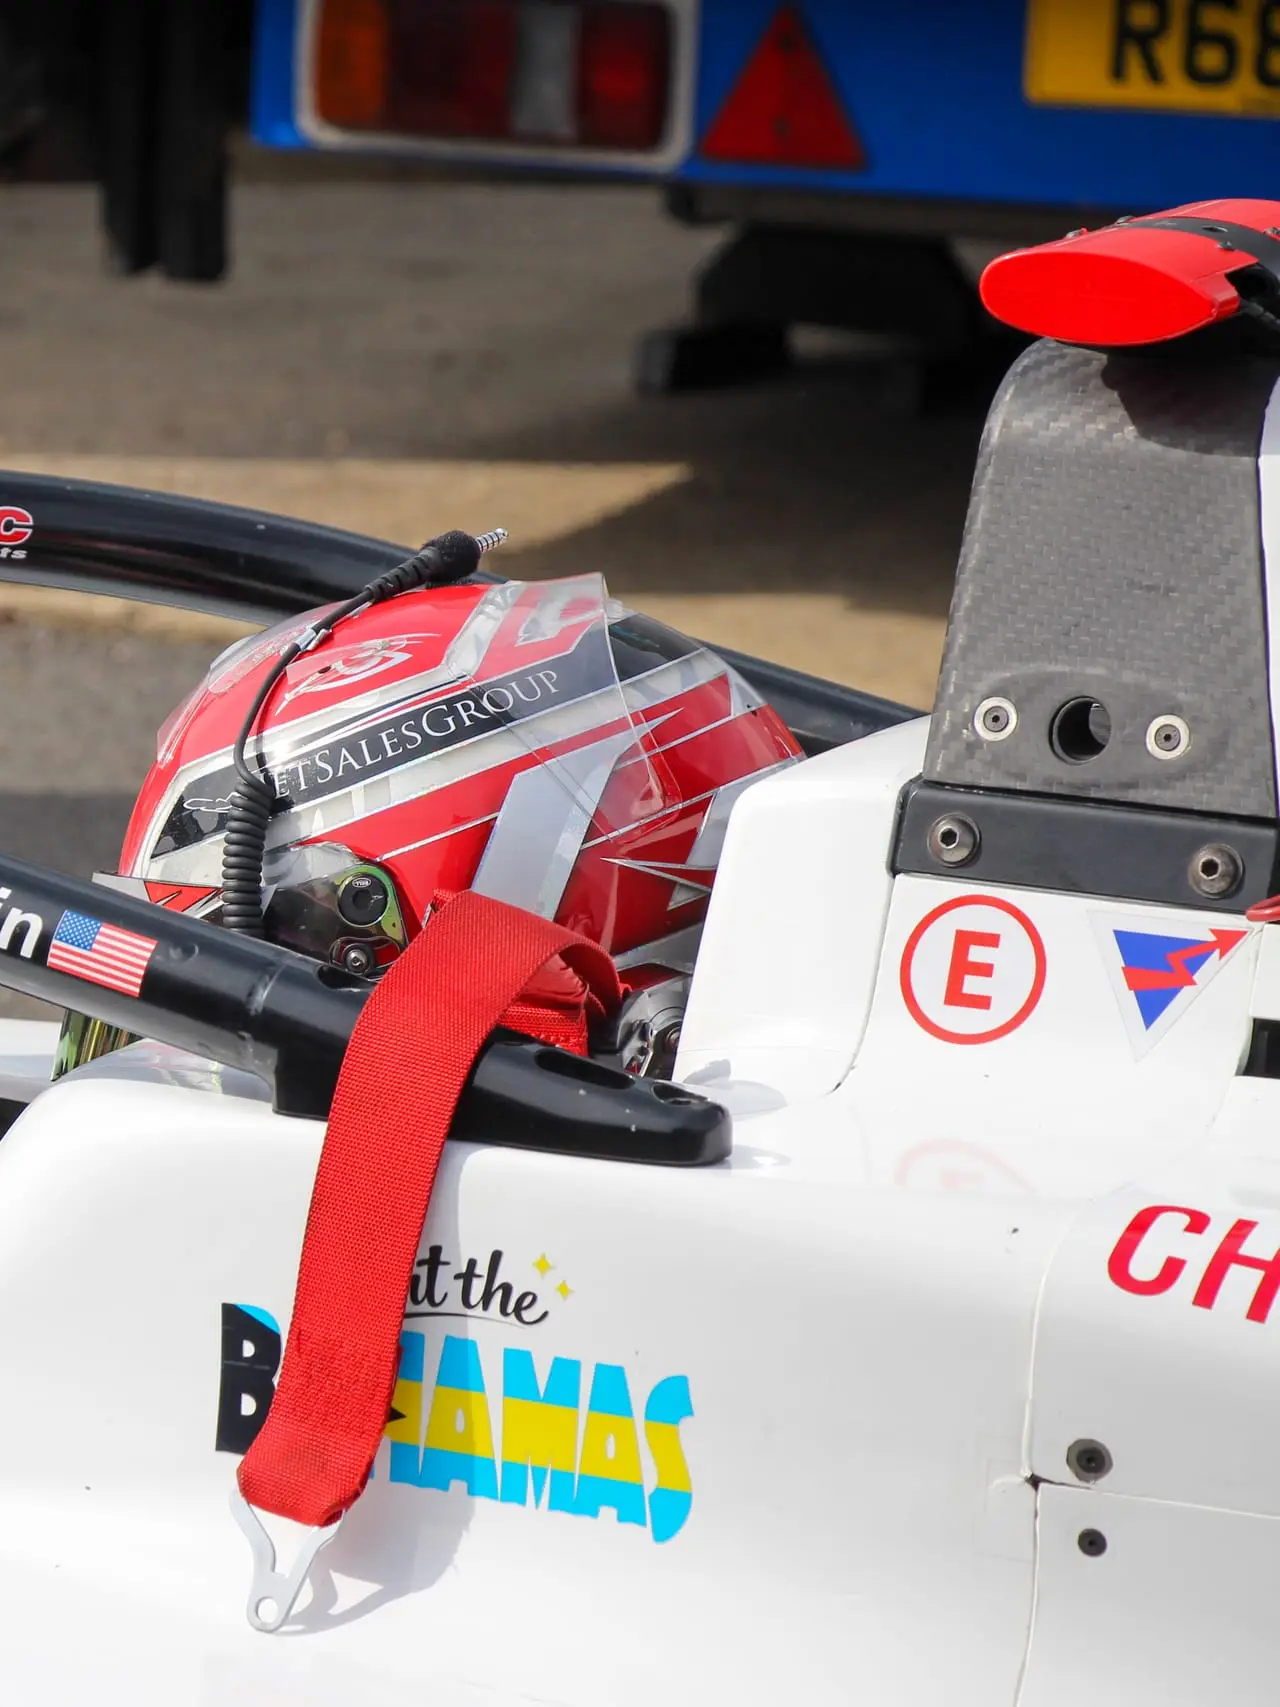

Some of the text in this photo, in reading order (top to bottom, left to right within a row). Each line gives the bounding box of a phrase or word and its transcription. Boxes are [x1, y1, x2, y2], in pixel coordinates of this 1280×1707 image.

[943, 928, 1002, 1011] E
[453, 1249, 550, 1326] the
[215, 1303, 694, 1544] BHAMAS
